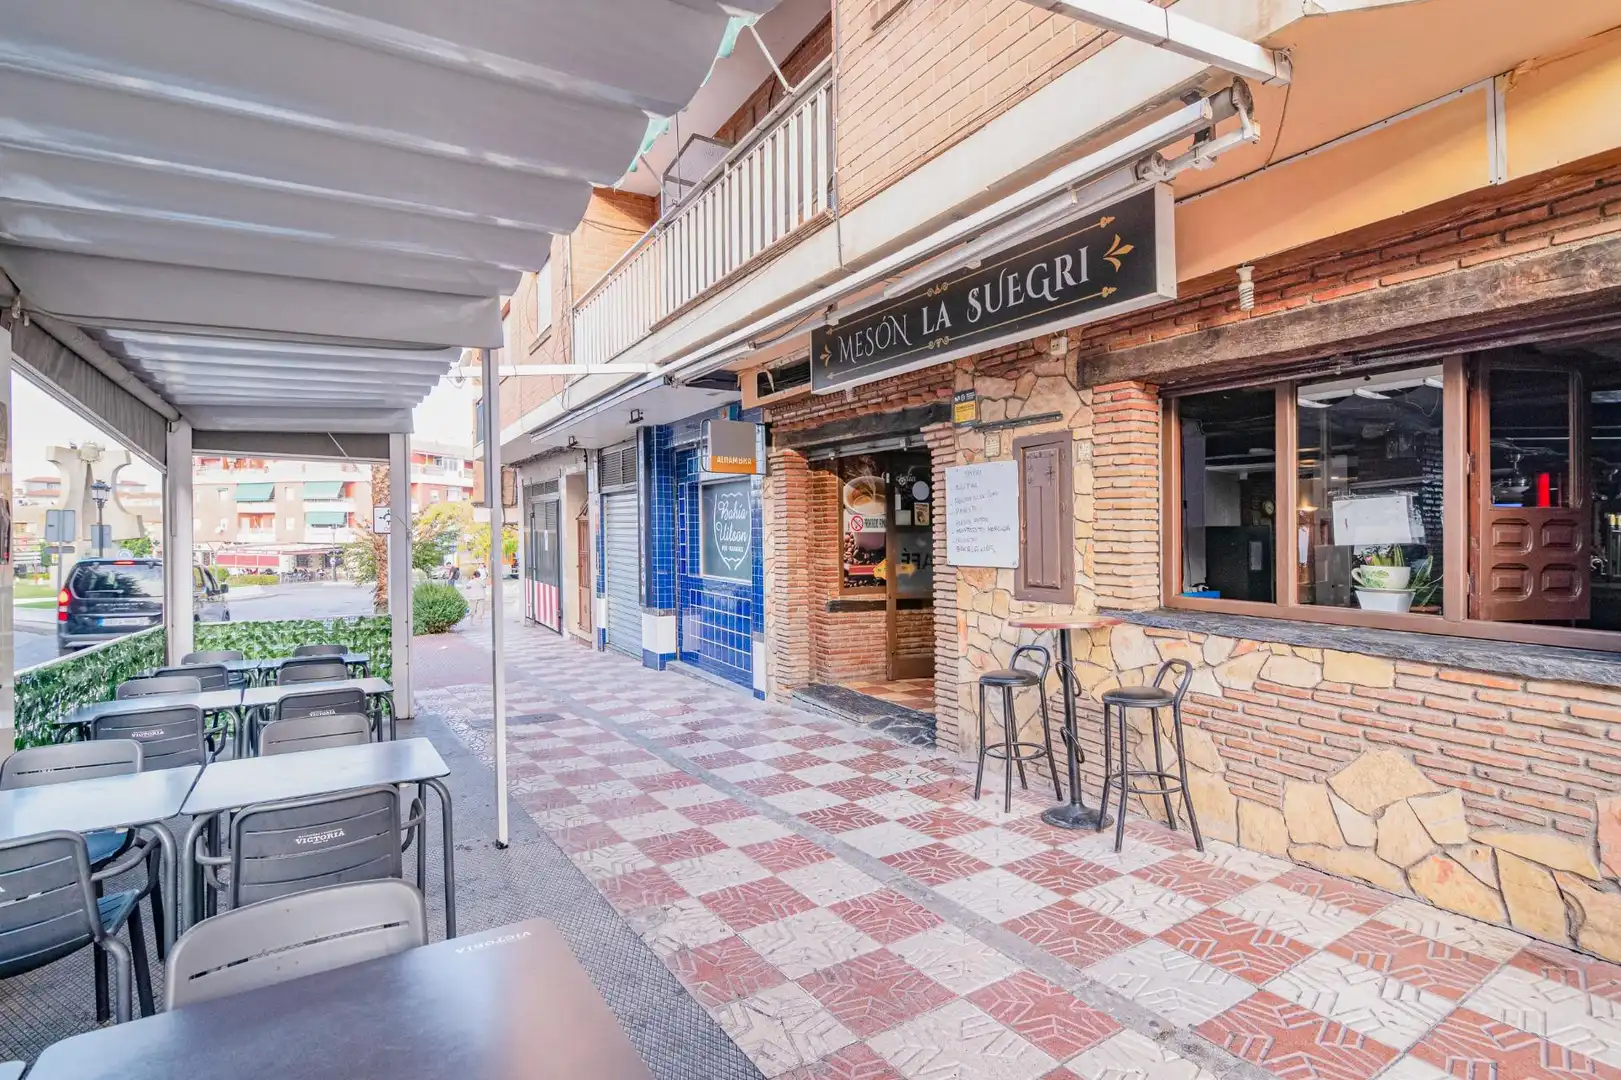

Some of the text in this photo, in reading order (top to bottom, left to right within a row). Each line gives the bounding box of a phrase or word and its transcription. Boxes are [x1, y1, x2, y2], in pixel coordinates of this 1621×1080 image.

[838, 246, 1090, 364] MESÓN LA SUEGRI
[296, 830, 345, 845] VICTORIA
